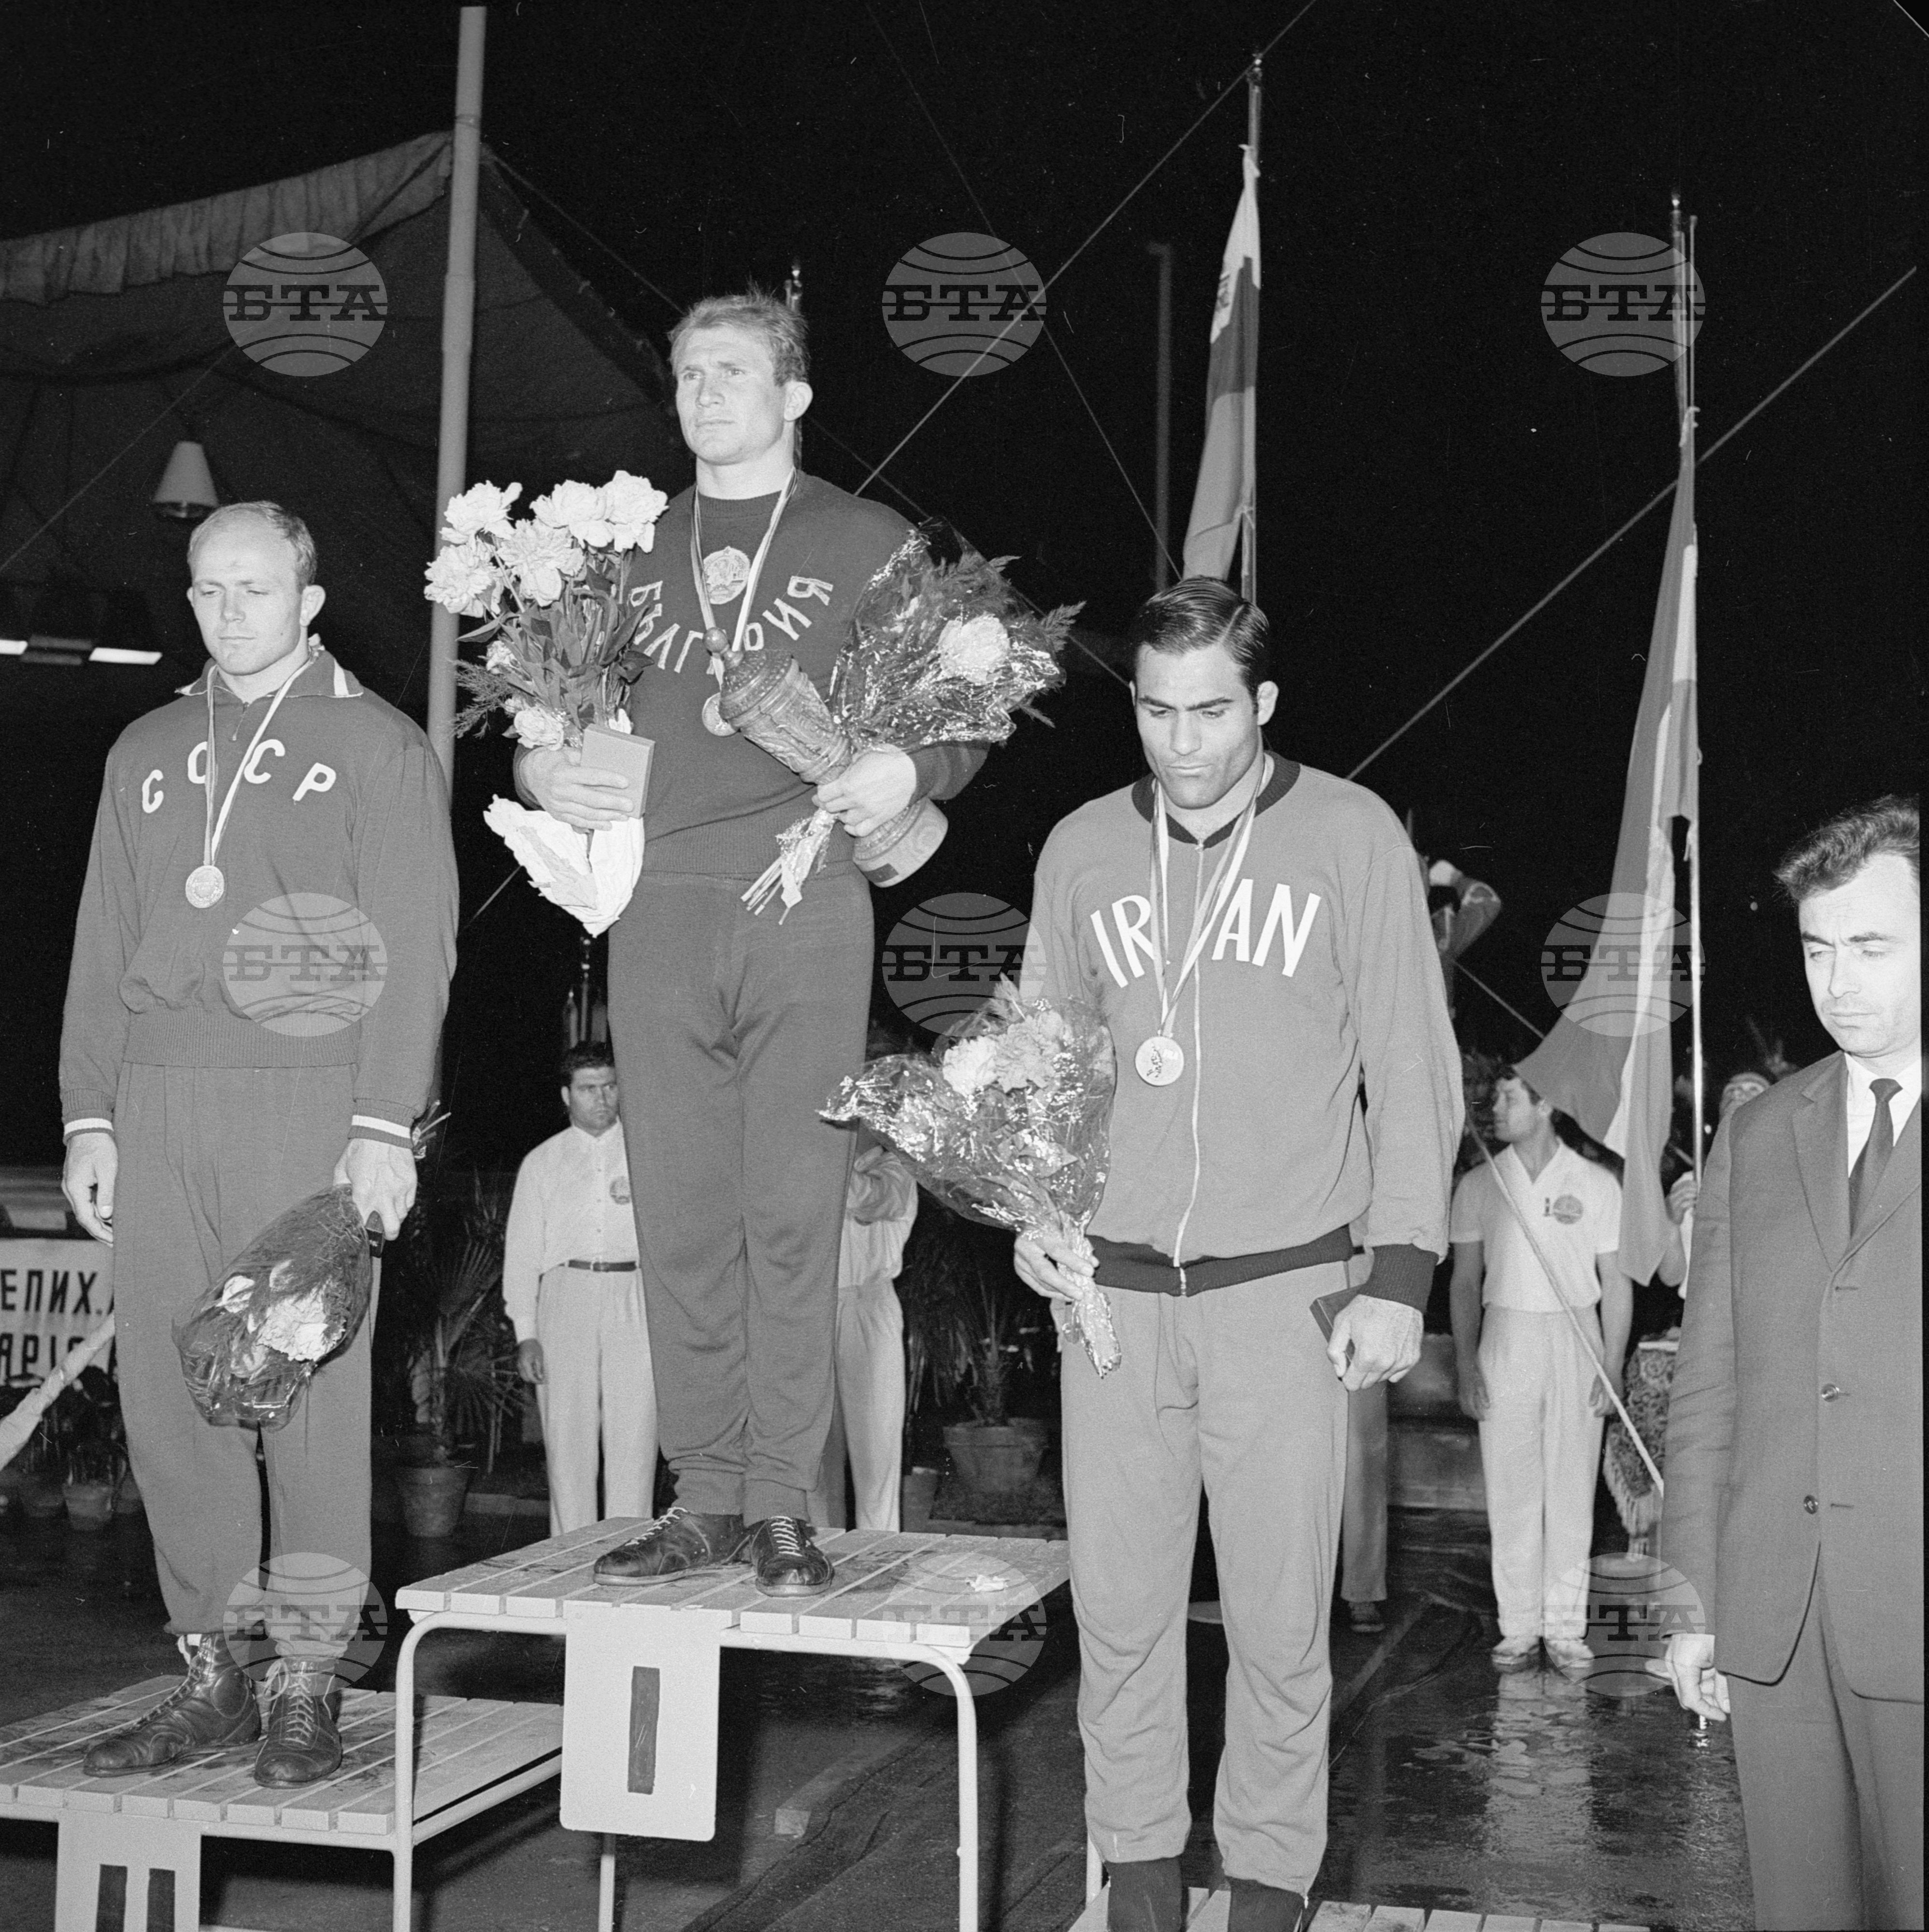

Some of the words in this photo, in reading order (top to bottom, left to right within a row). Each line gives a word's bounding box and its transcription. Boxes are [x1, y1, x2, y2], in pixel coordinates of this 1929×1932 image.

[629, 575, 834, 674] БЪЛГРИЯ
[142, 739, 337, 814] СССР
[1090, 878, 1321, 988] IRAN
